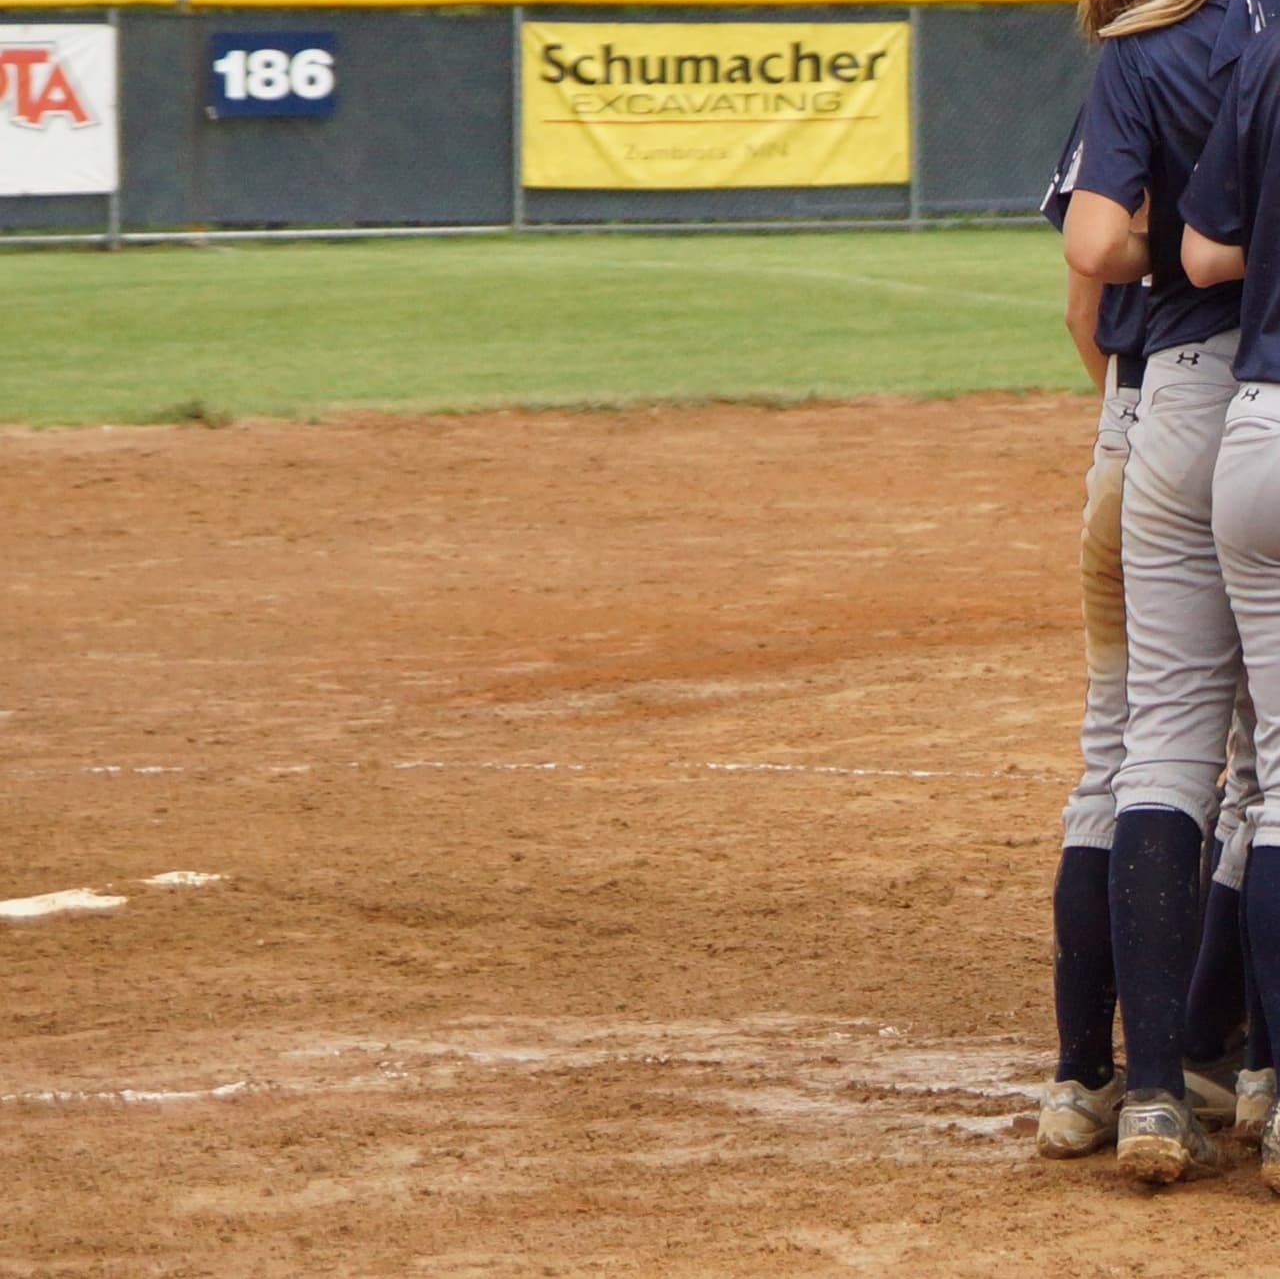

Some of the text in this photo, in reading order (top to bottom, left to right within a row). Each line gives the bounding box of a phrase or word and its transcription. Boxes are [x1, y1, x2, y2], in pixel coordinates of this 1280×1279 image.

[0, 49, 90, 123] TA
[213, 49, 335, 100] 186
[540, 41, 887, 85] Schumacher
[572, 91, 842, 114] EXCAVATING
